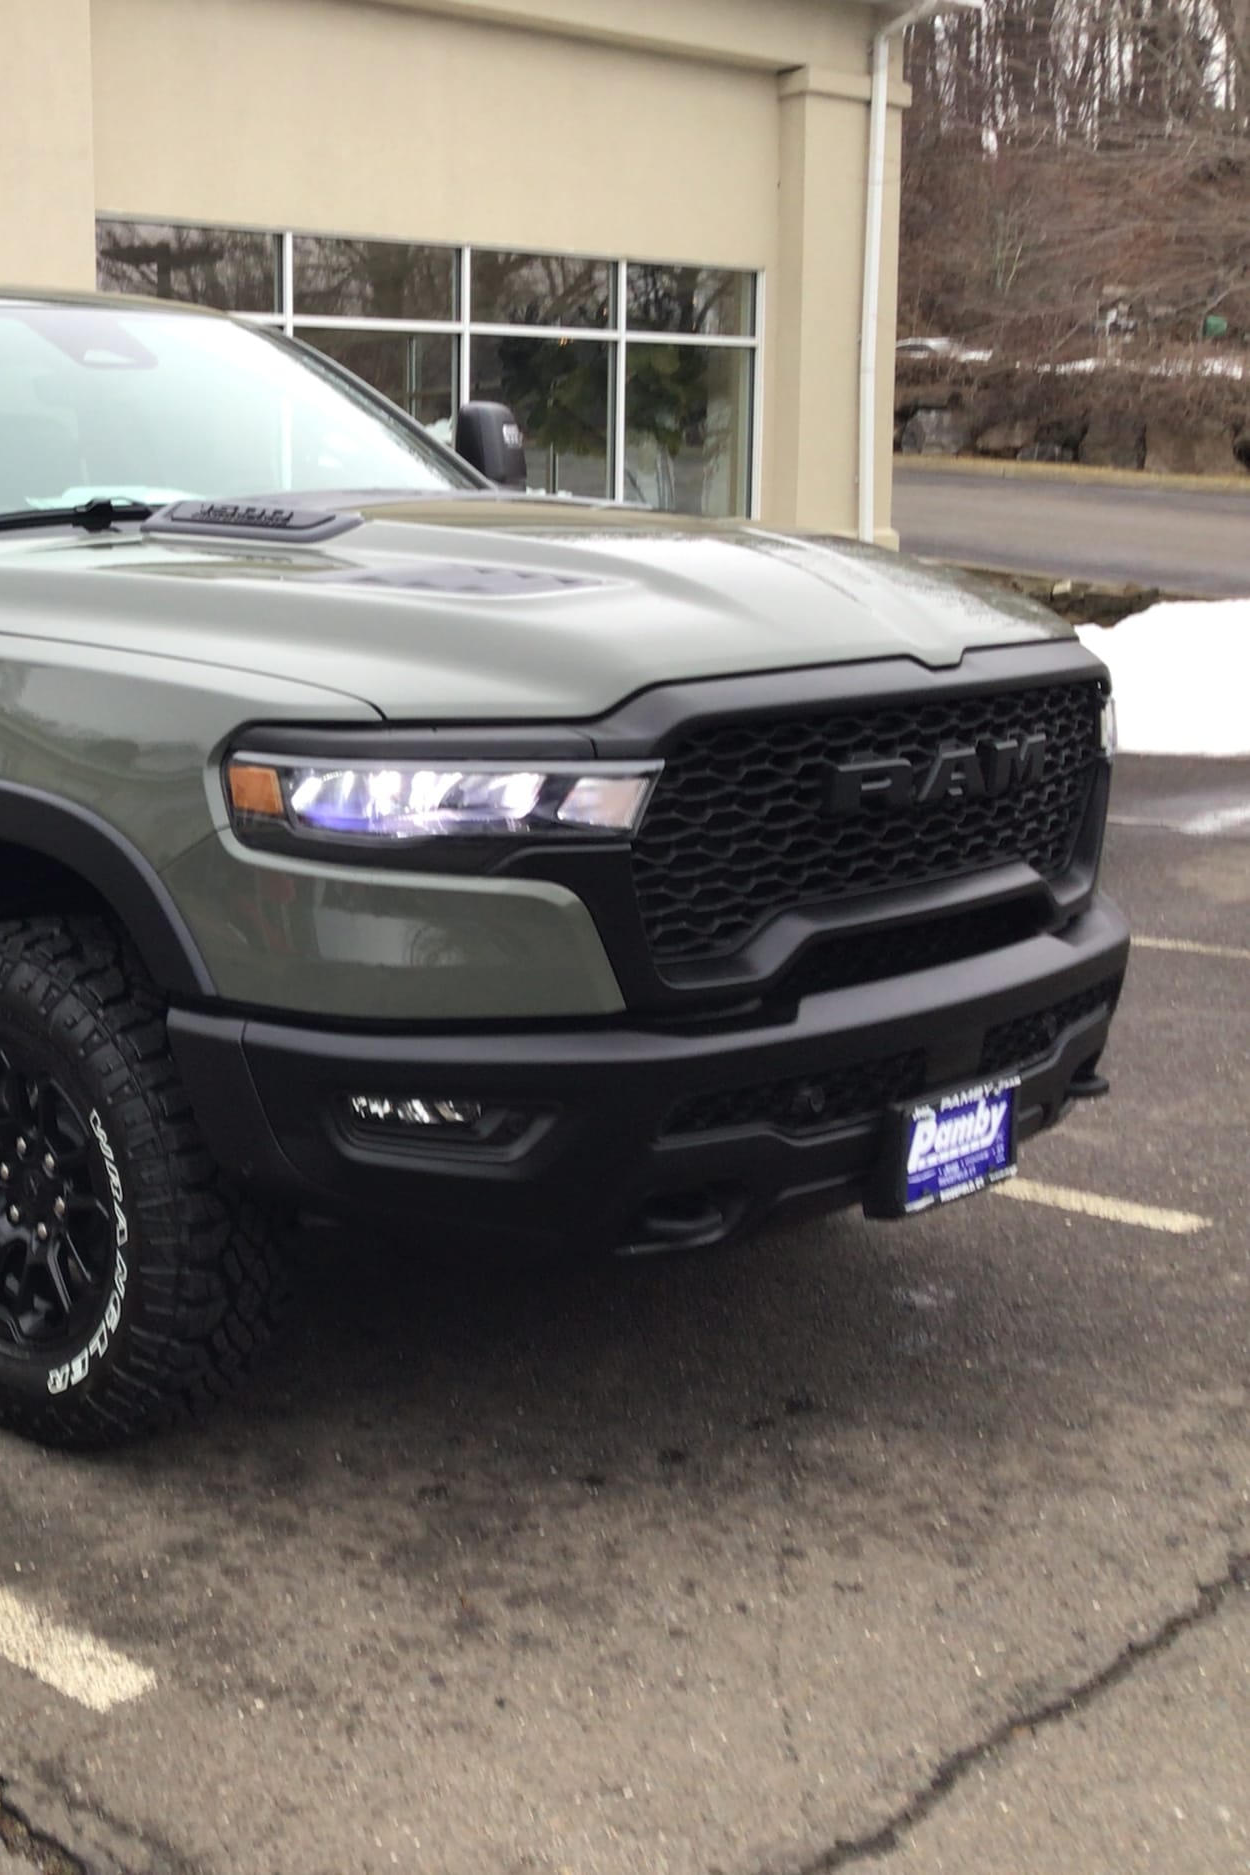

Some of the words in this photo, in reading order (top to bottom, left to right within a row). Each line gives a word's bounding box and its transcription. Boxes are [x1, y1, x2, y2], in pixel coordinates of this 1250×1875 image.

[832, 733, 1047, 814] RAM
[906, 1098, 1008, 1175] Pamby
[46, 1108, 128, 1395] WRANGLER
